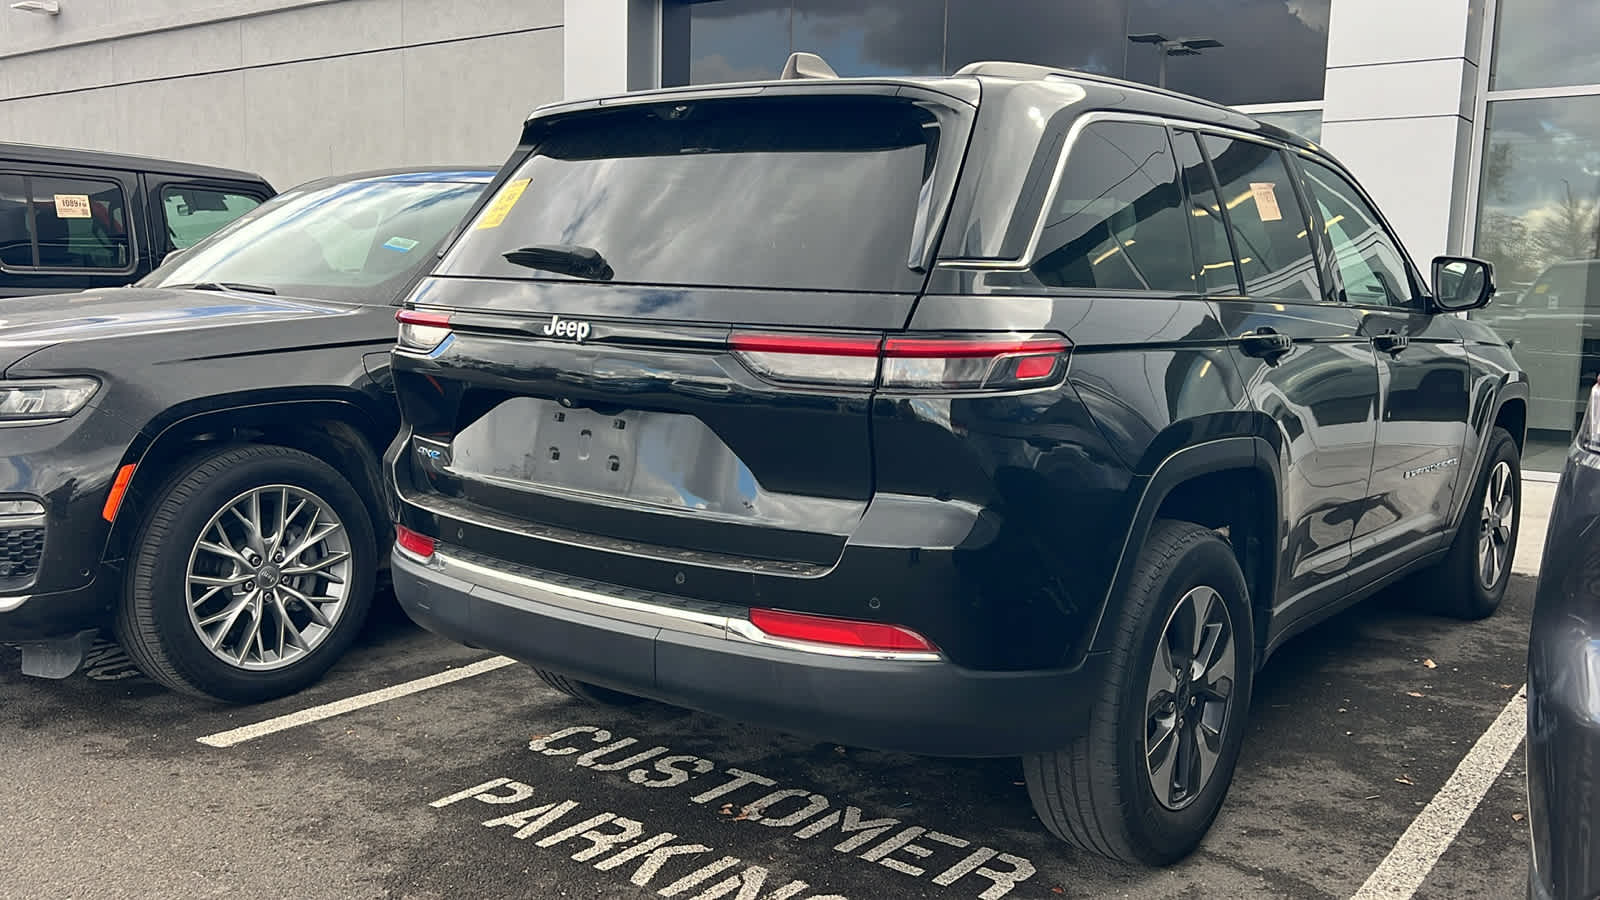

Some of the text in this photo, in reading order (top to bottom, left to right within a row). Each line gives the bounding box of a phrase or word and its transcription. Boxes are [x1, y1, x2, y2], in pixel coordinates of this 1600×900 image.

[543, 314, 590, 341] Jeep
[428, 777, 848, 900] PARKIN
[528, 725, 1037, 900] CUSTOMER
